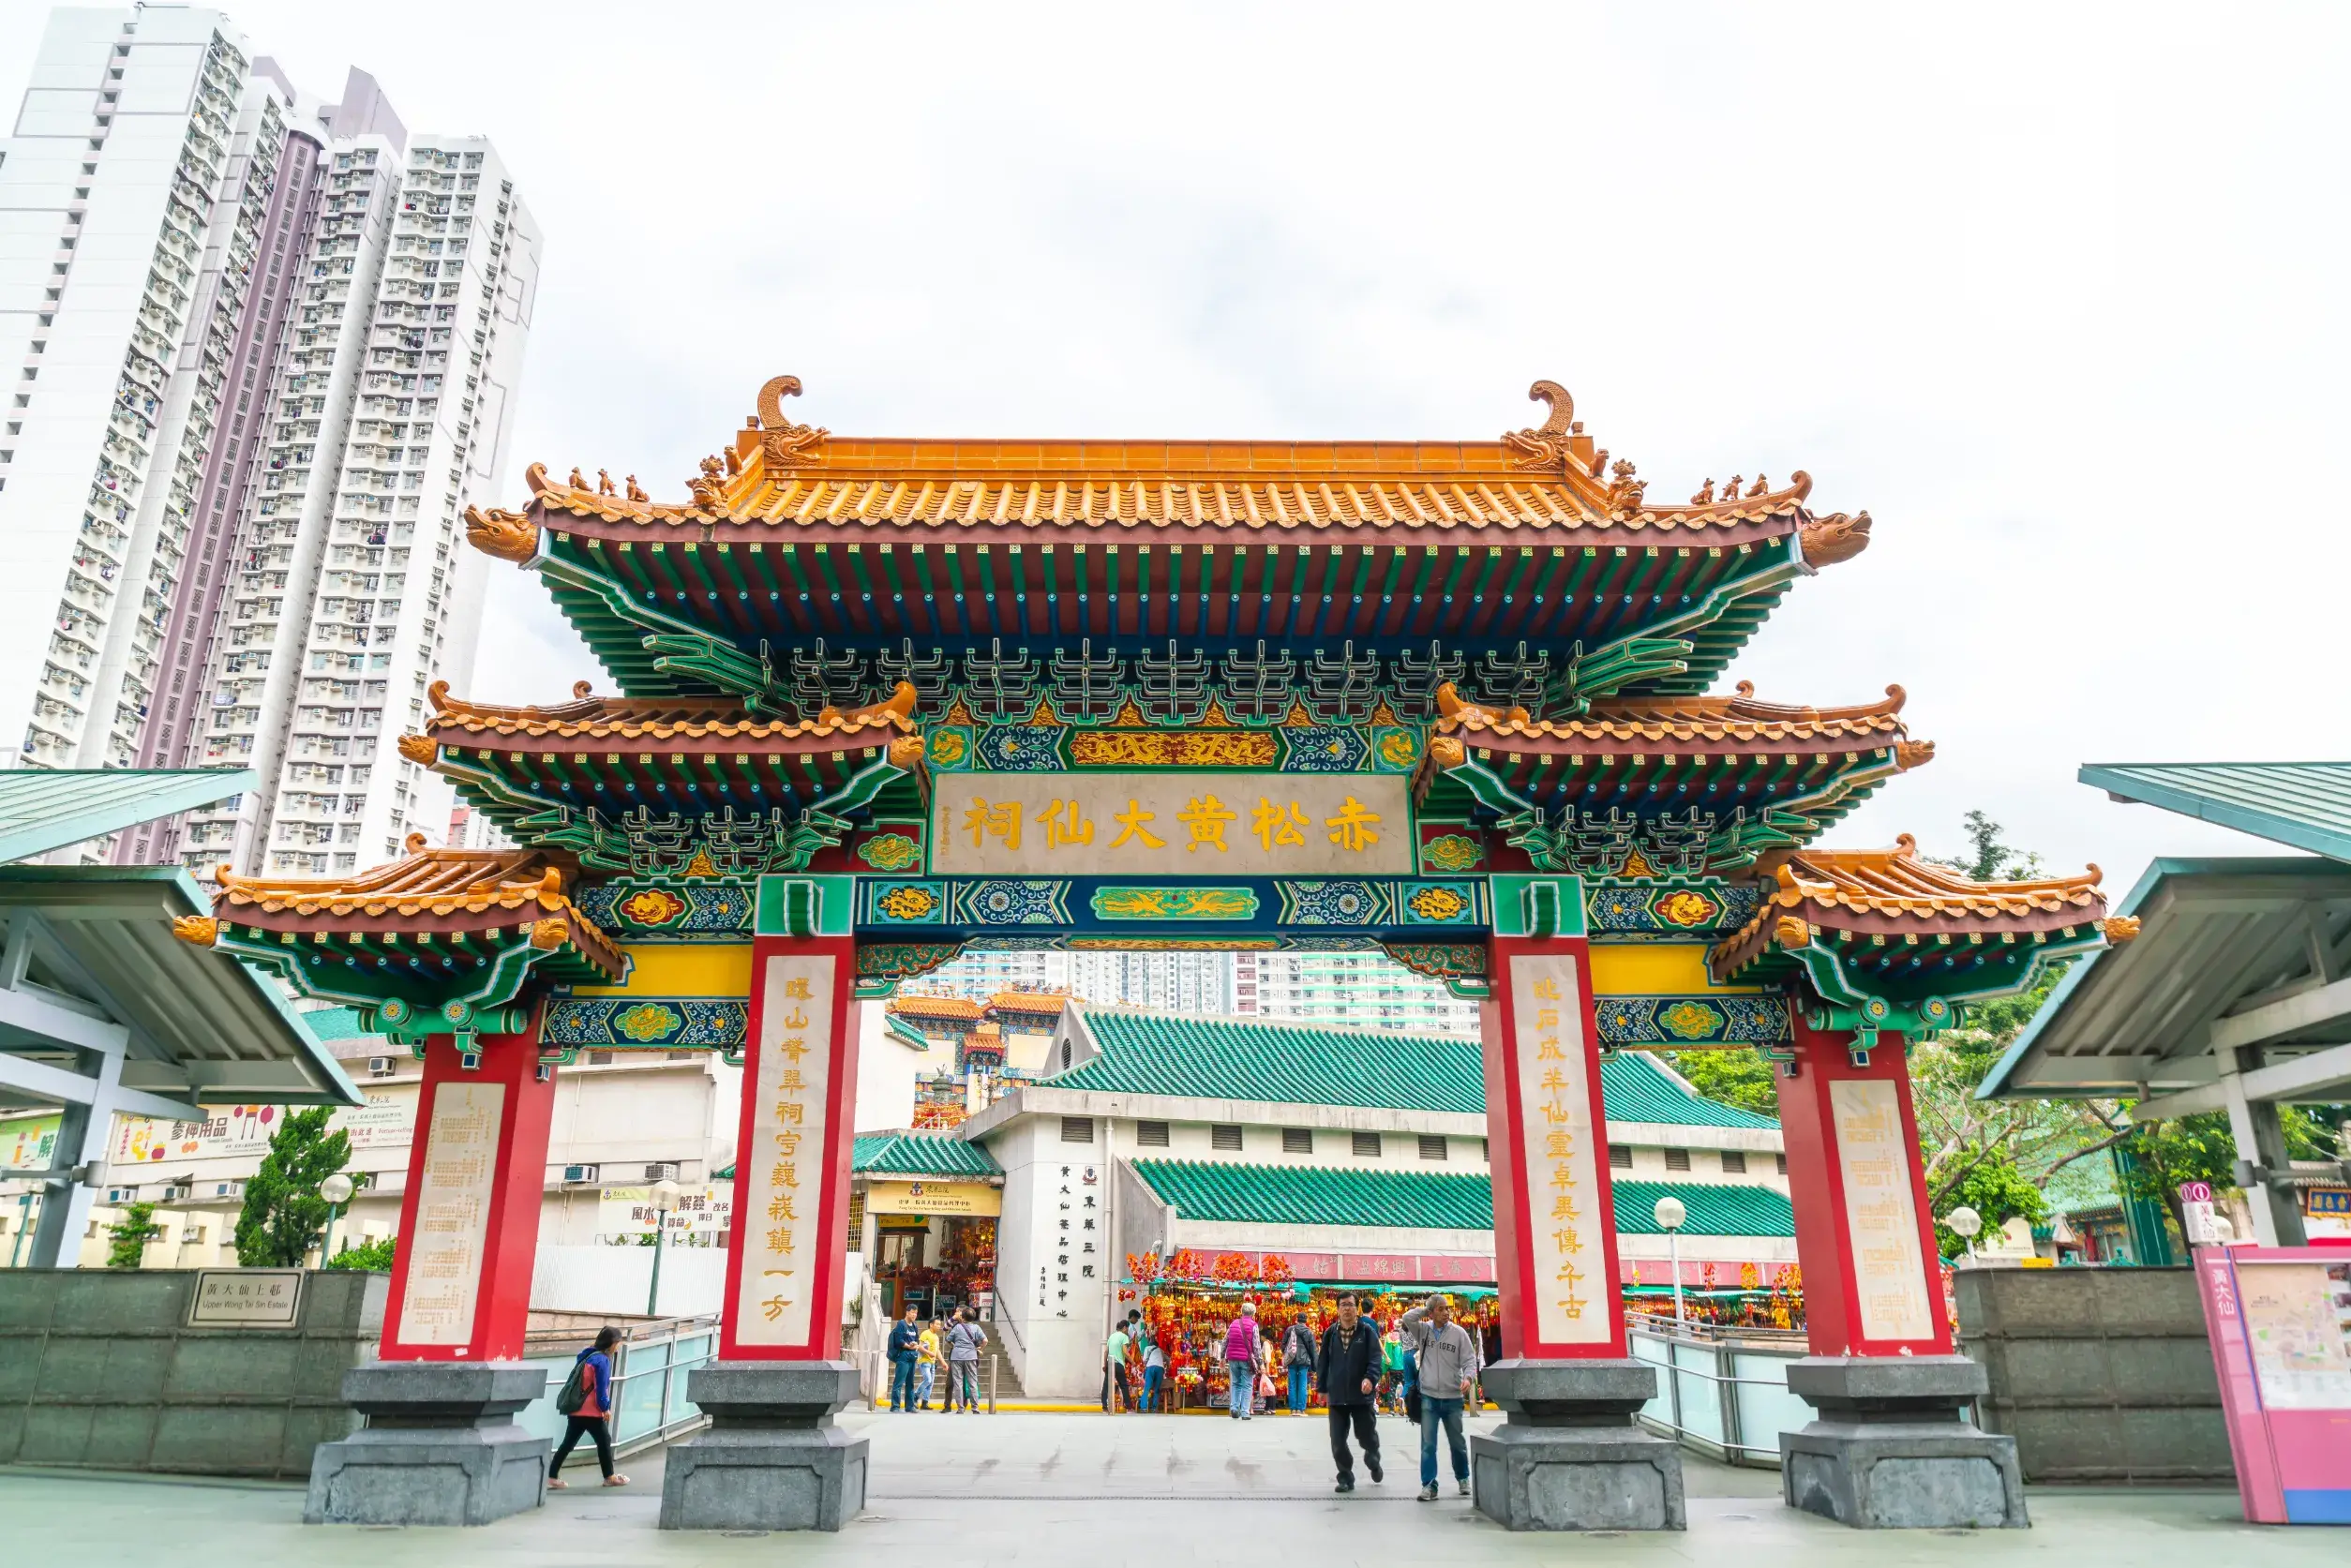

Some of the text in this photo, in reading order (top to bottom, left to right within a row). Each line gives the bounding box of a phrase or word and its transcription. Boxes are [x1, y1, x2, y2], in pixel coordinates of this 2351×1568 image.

[712, 1202, 729, 1212] 改名
[631, 1206, 655, 1220] 風水
[666, 1217, 685, 1228] 算命
[1082, 1195, 1097, 1278] 東華三院
[202, 1300, 289, 1310] Upper Wong Tai Sin Estate
